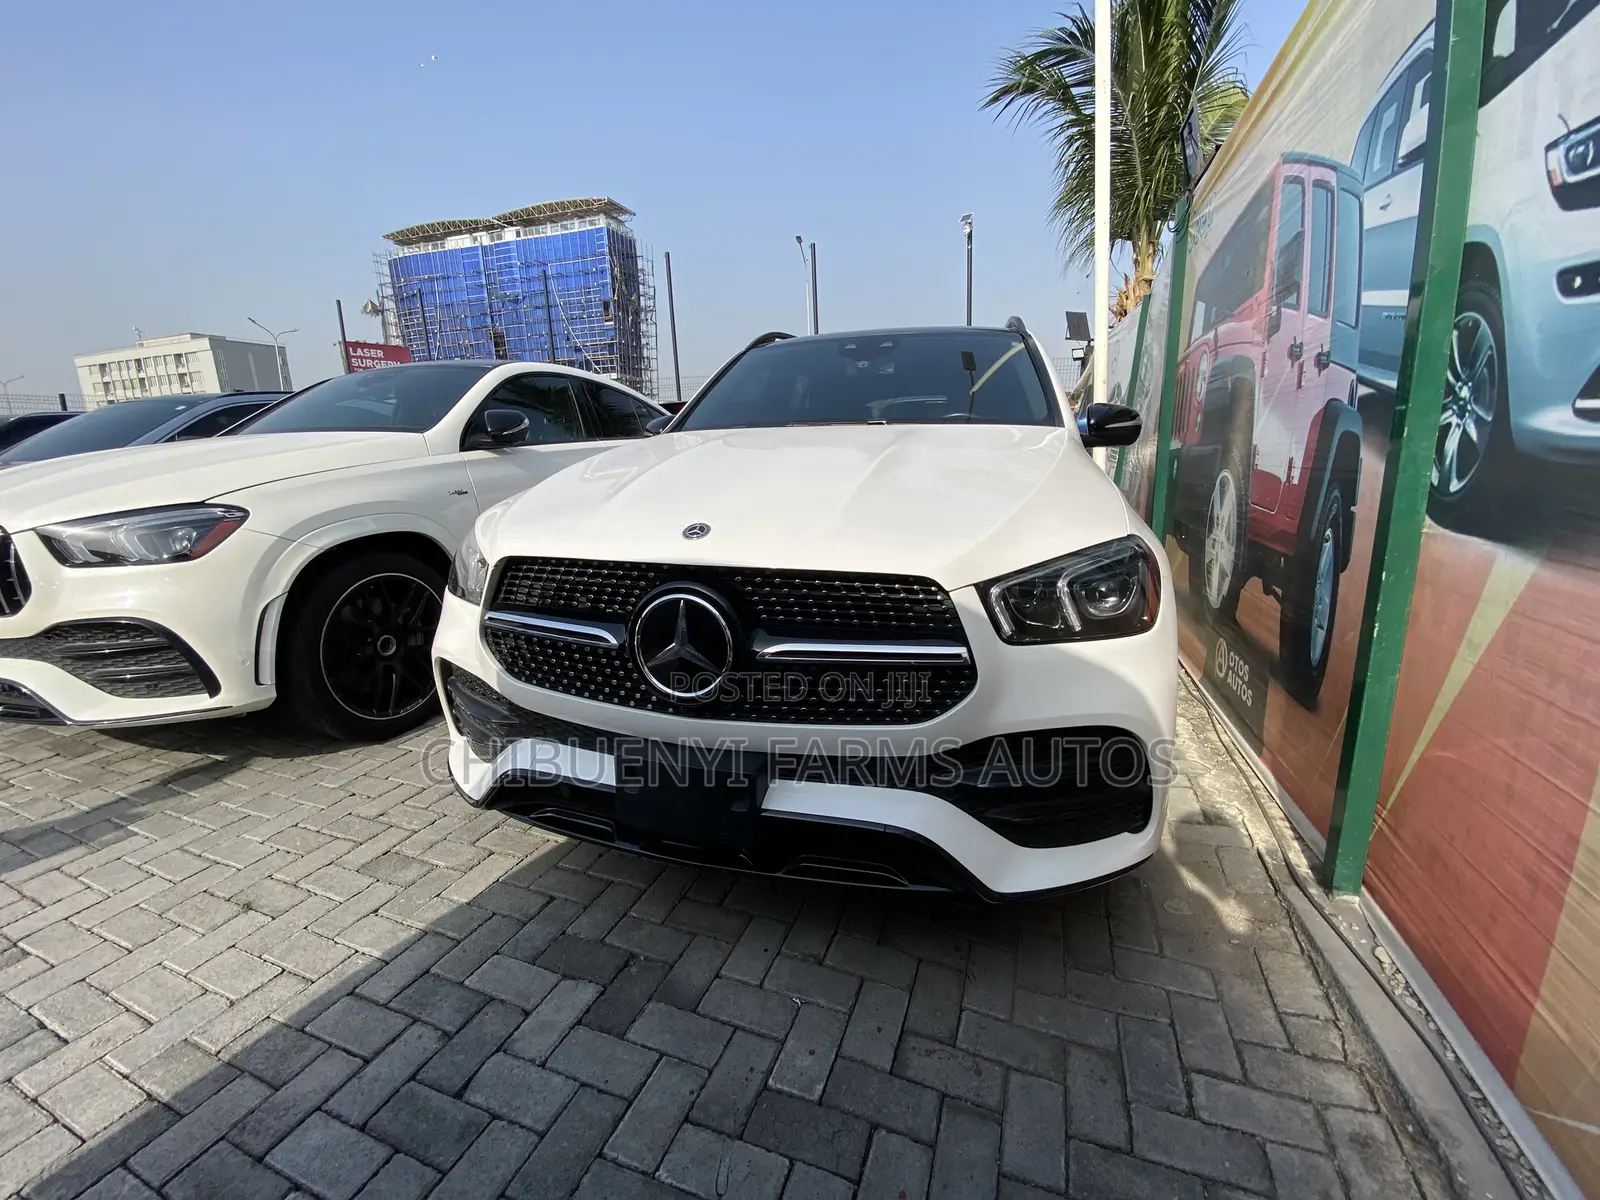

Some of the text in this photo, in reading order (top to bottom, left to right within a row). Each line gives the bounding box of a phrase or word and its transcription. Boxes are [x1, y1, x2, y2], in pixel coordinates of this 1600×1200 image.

[349, 347, 384, 358] LASER
[1229, 651, 1250, 682] OTOS
[1227, 669, 1253, 707] AUTOS
